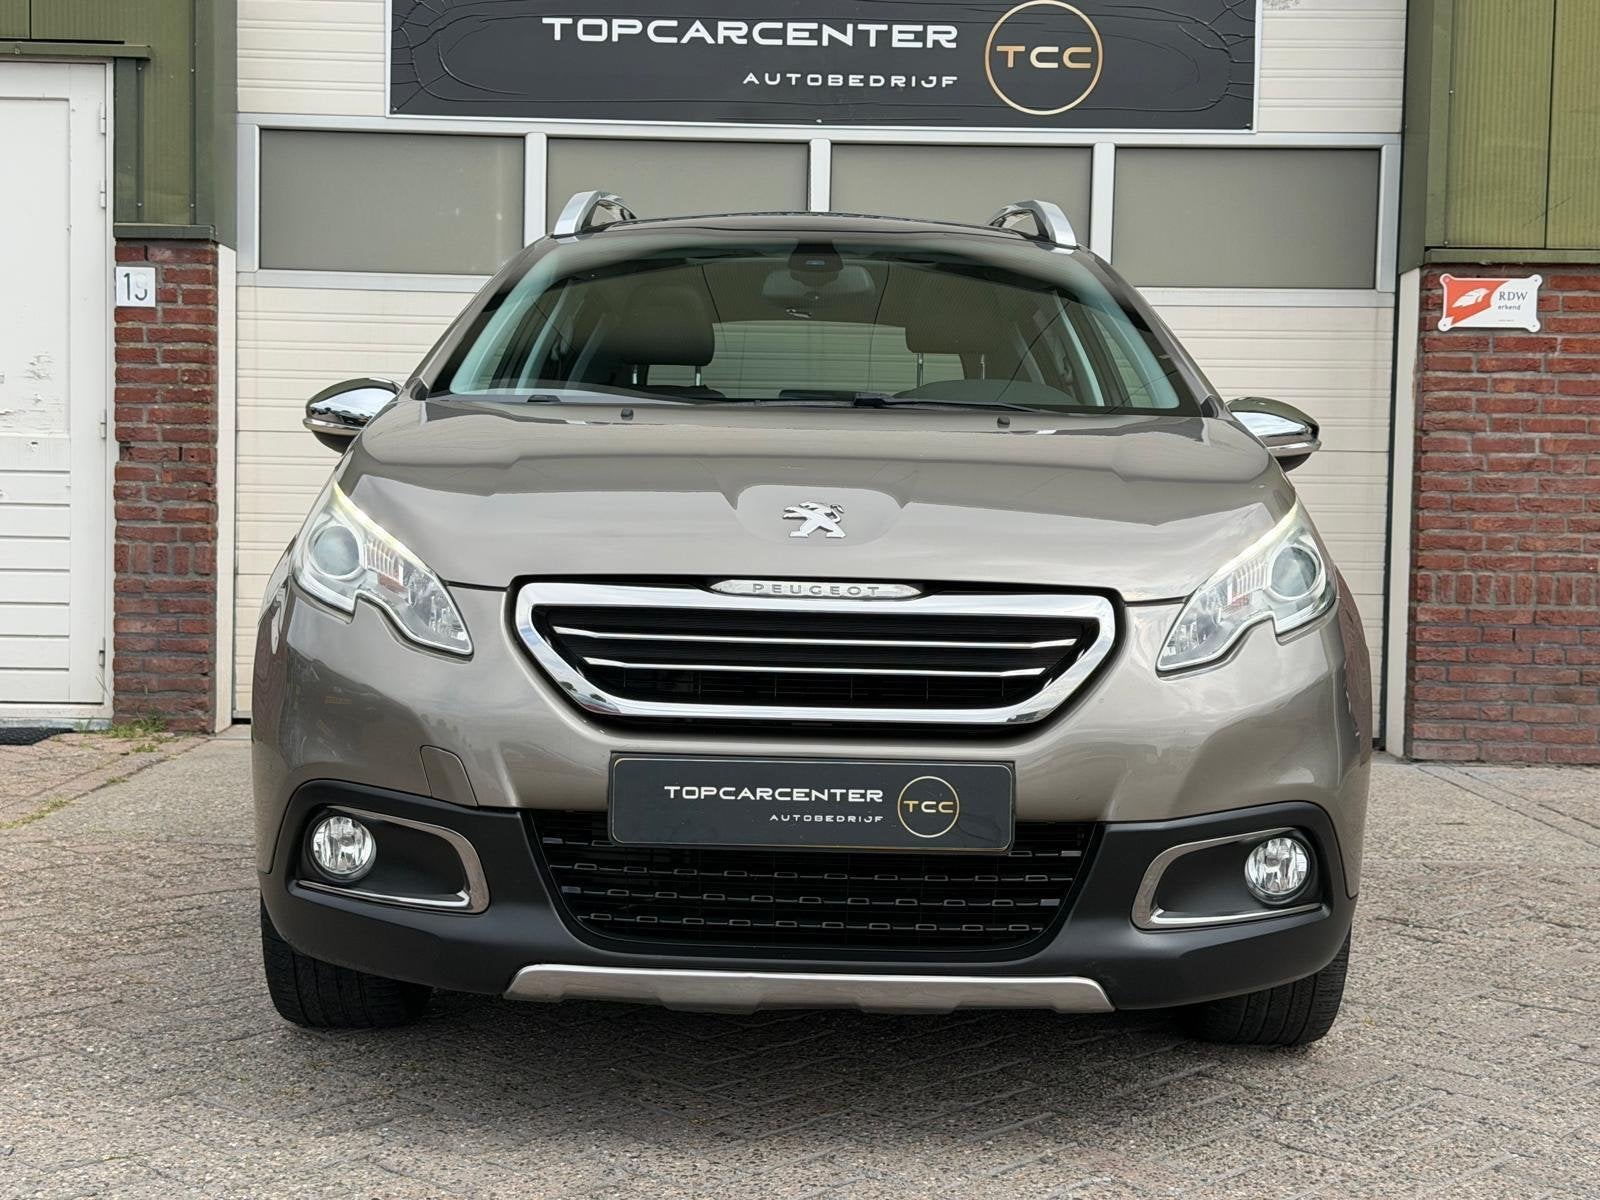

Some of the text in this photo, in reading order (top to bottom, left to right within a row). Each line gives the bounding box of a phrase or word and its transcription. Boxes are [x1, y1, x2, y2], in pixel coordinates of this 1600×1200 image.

[542, 17, 958, 48] TOPCARCENTER
[996, 44, 1093, 69] TCC
[742, 72, 958, 89] AUTOBEDRIJF
[1498, 291, 1529, 301] RDW
[752, 583, 879, 595] PEUGEOT
[664, 785, 883, 803] TOPCARCENTER
[903, 800, 954, 813] TCC
[769, 814, 884, 823] AUTOBEDRIJF
